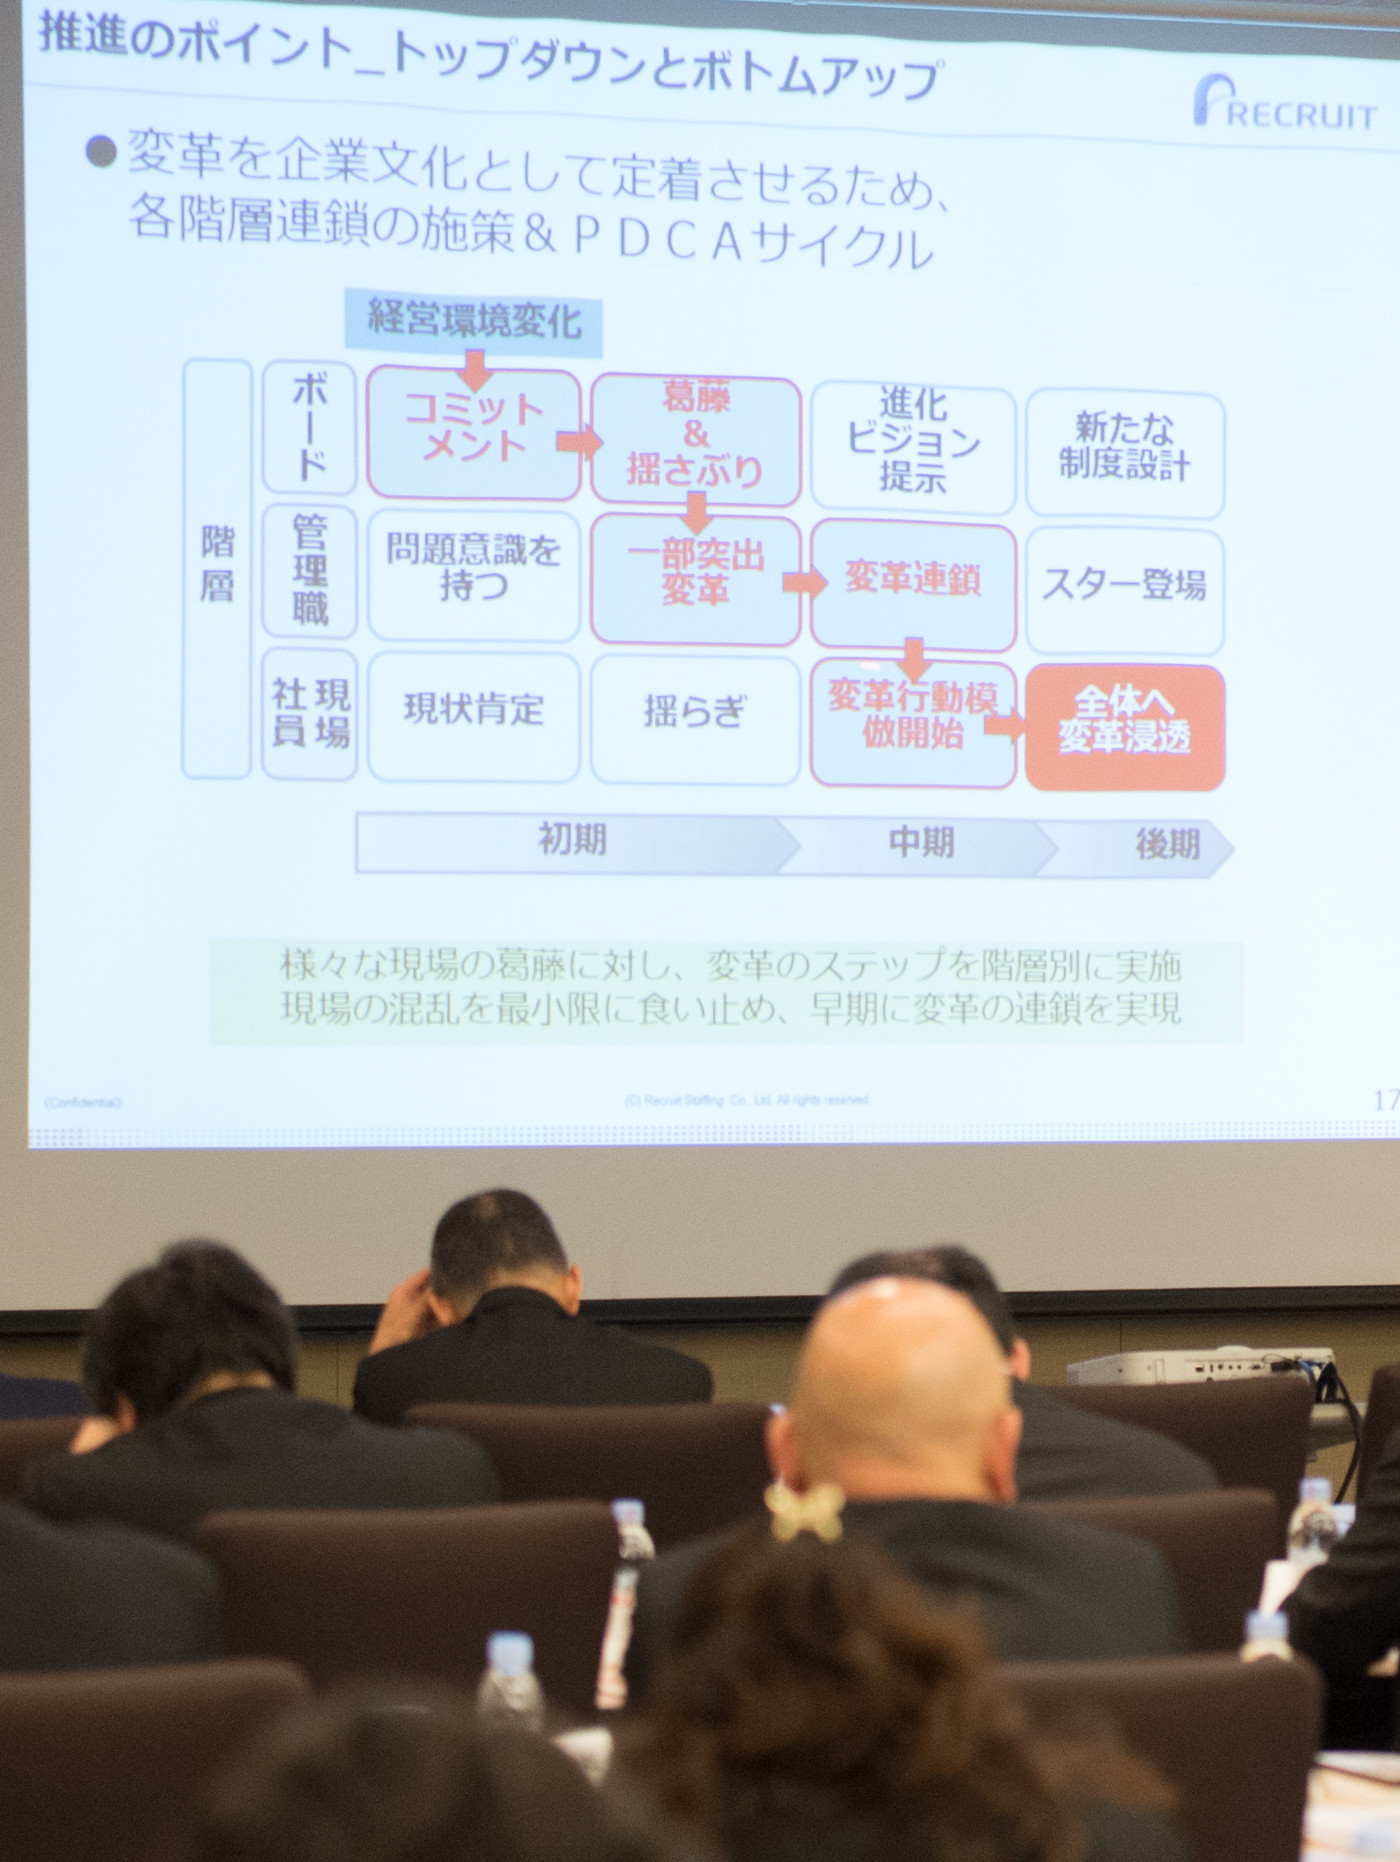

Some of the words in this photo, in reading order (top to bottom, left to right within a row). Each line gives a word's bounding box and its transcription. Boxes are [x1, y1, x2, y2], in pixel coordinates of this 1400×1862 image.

[38, 9, 945, 101] 推進のポイント_トップダウンとボトムアップ
[1227, 101, 1379, 130] RECRUIT
[127, 127, 949, 213] 変革を企業文化として定着させるため、
[368, 297, 583, 340] 経営環境変化
[406, 391, 543, 427] コミット
[662, 378, 731, 414] 葛藤
[879, 386, 948, 424] 進化
[292, 370, 328, 483] ボード
[683, 420, 711, 448] &
[847, 419, 982, 460] ビジョン
[1075, 410, 1175, 447] 新たな
[424, 429, 526, 463] メント
[1059, 446, 1191, 483] 制度設計
[626, 451, 763, 490] 揺さぶり
[879, 459, 948, 495] 提示
[201, 524, 235, 602] 階層
[386, 531, 562, 568] 問題意識を
[627, 536, 765, 573] 一部突出
[292, 513, 328, 626] 管理職
[440, 567, 509, 602] 持つ
[845, 559, 982, 598] 変革連鎖
[1043, 567, 1207, 601] スター登場
[661, 573, 730, 608] 変革
[271, 677, 307, 749] 社員
[315, 677, 351, 750] 現場
[403, 692, 544, 726] 現状肯定
[643, 693, 748, 730] 揺らぎ
[828, 677, 998, 715] 変革行動模
[1074, 682, 1175, 719] 全体へ
[862, 715, 965, 751] 倣開始
[1058, 718, 1192, 756] 変革浸透
[538, 821, 607, 857] 初期
[888, 825, 955, 860] 中期
[1136, 827, 1202, 861] 後期
